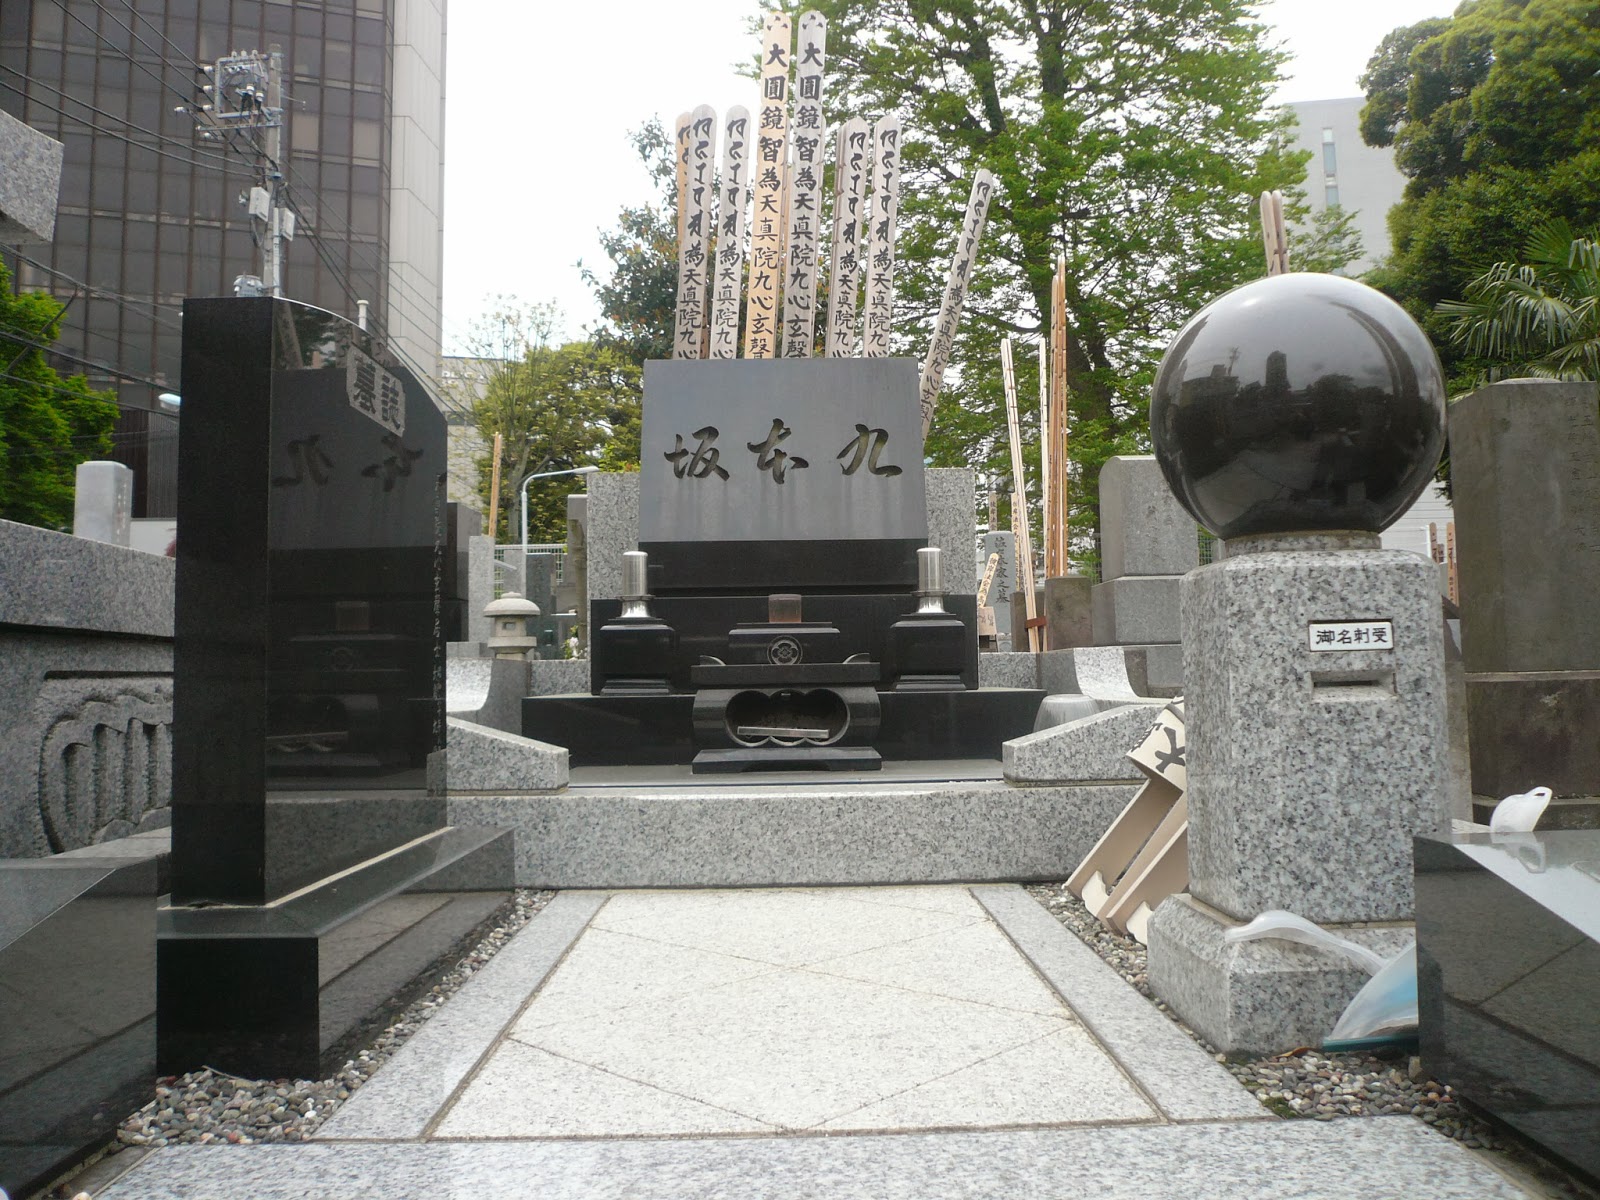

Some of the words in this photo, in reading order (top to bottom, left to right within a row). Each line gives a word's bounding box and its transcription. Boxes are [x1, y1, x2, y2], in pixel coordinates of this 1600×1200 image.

[663, 417, 903, 485] 坂本九
[1315, 627, 1389, 645] 御名刺受
